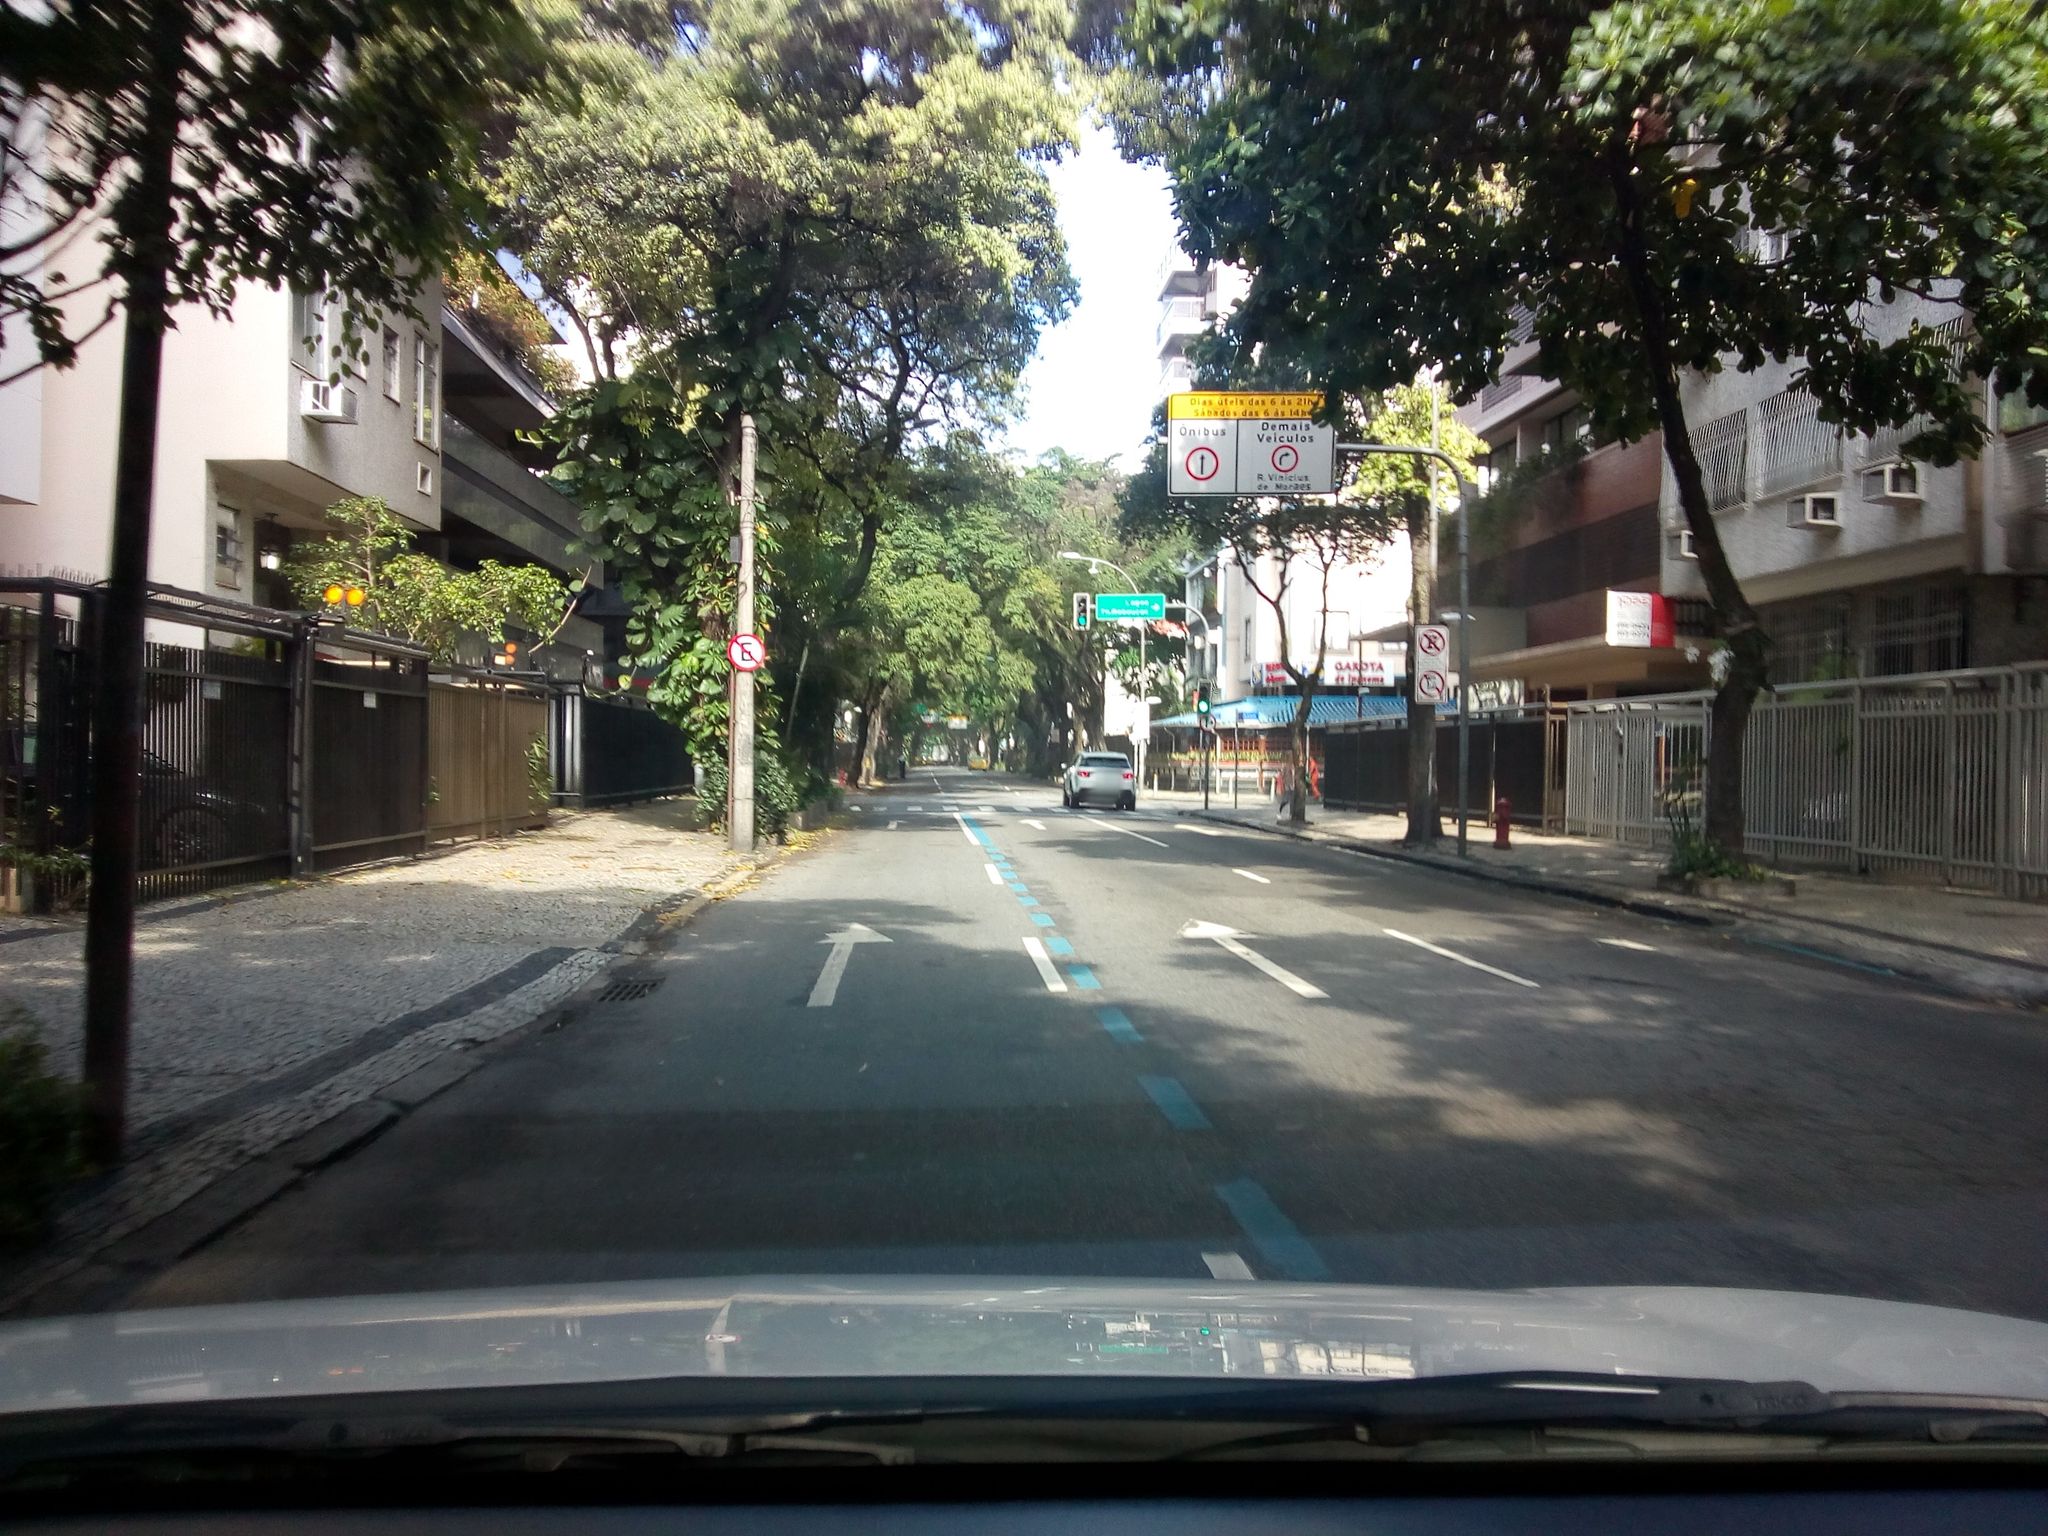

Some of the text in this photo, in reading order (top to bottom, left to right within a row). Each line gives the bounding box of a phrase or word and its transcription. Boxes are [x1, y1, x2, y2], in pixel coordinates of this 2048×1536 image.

[1190, 397, 1213, 406] Dias
[1217, 397, 1244, 406] úteis
[1248, 397, 1266, 406] das
[1270, 398, 1276, 406] 6
[1280, 396, 1292, 406] às
[1194, 408, 1237, 417] Sábados
[1241, 409, 1259, 417] das
[1263, 409, 1269, 417] 6
[1273, 408, 1285, 417] às
[1180, 424, 1226, 436] Ônibus
[1261, 422, 1310, 431] Demais
[1335, 661, 1384, 672] GAROTA
